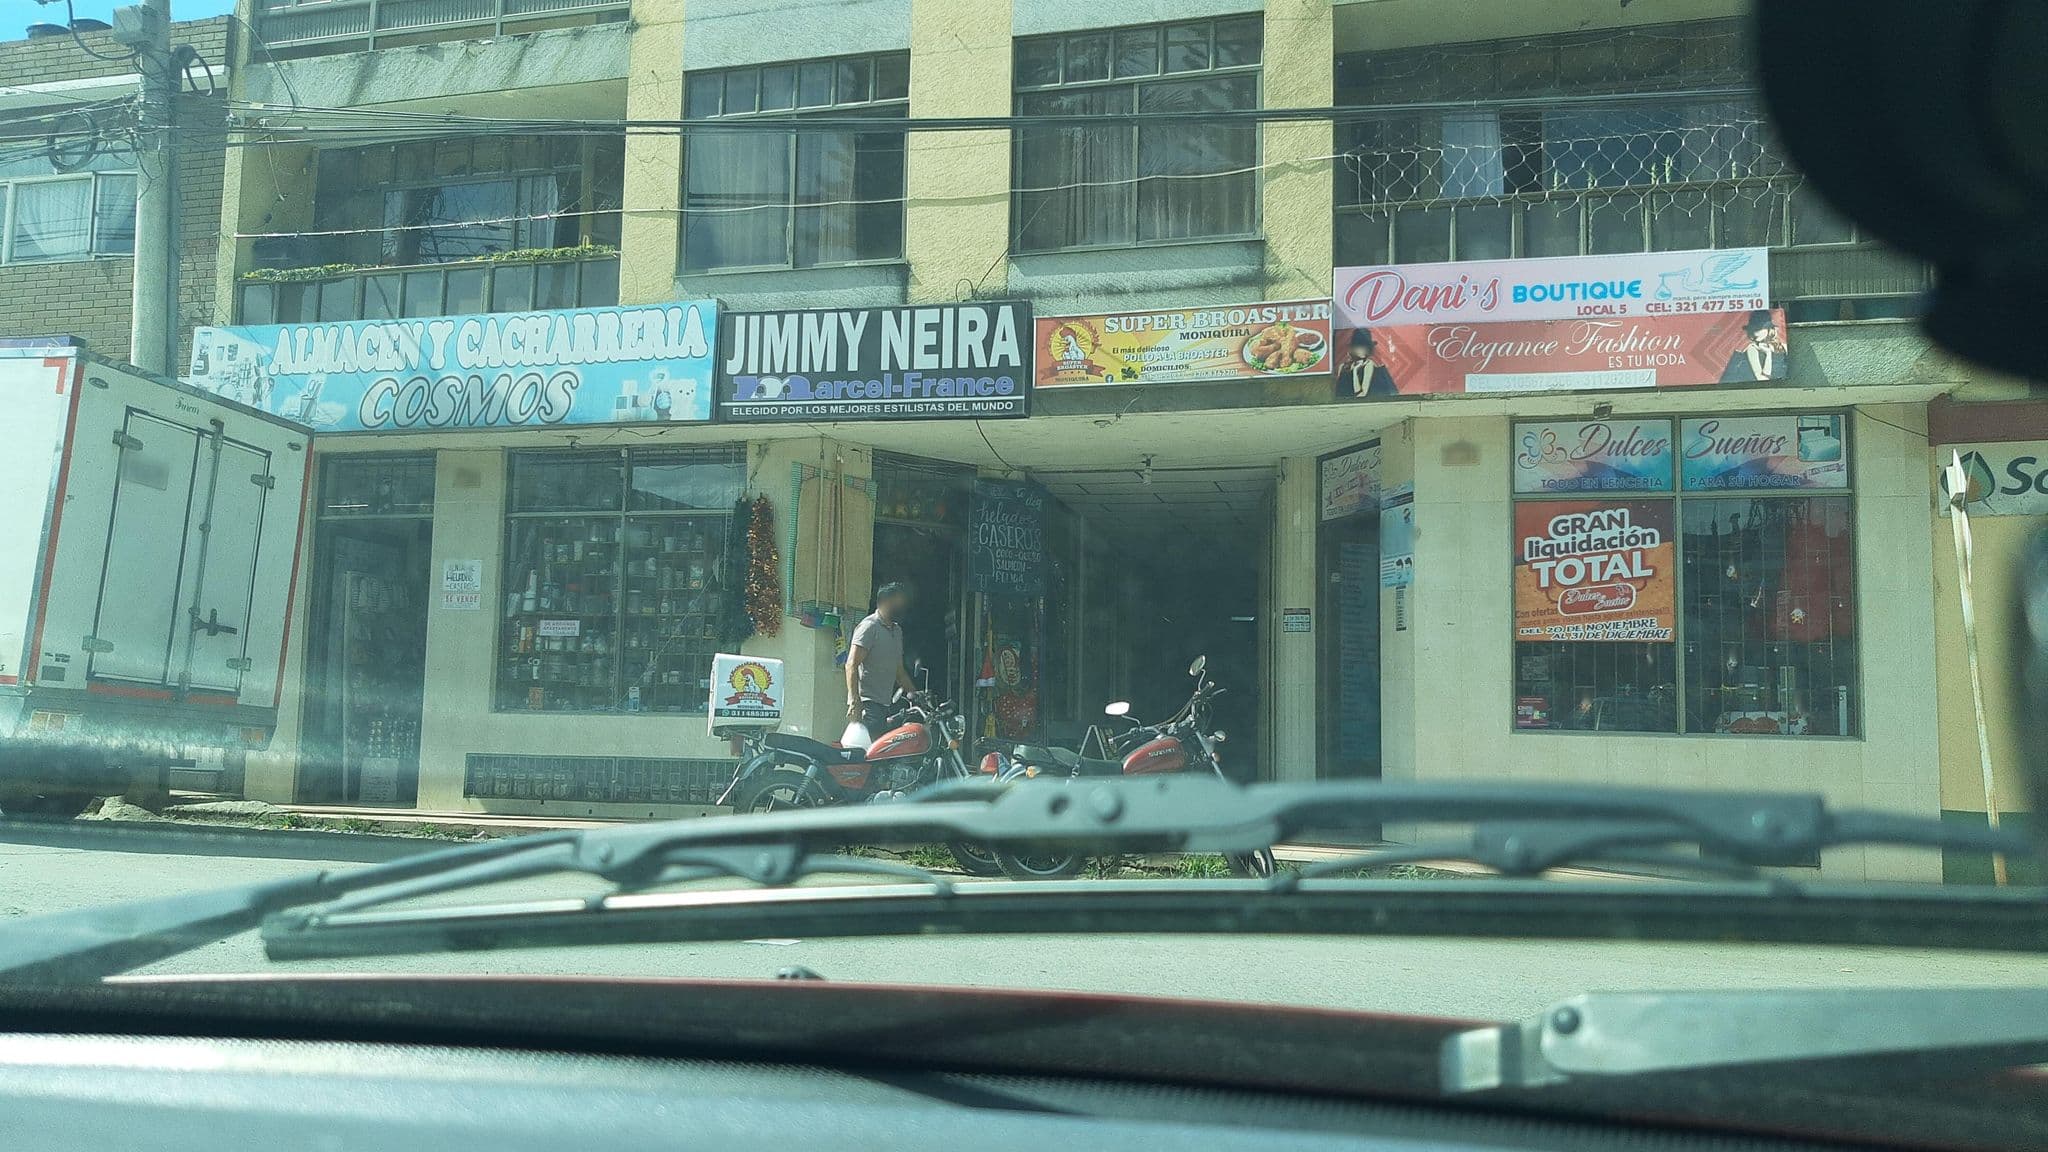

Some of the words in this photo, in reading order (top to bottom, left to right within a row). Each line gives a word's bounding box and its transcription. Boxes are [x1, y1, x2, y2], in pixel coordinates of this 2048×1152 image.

[1345, 269, 1501, 324] Dani's
[1512, 279, 1642, 304] BOUTIQUE
[1577, 304, 1617, 315] LOCAL
[1619, 303, 1627, 314] 5
[1645, 302, 1672, 313] CEL:
[1676, 302, 1697, 312] 321
[1702, 300, 1725, 311] 477
[1729, 299, 1744, 310] 55
[1748, 298, 1763, 309] 10
[1104, 313, 1187, 333] SUPER
[1187, 303, 1331, 328] BROASTER
[269, 320, 424, 375] ALMACEN
[427, 320, 455, 370] Y
[456, 305, 709, 369] CACHARRERIA
[726, 311, 869, 375] JIMMY
[880, 305, 1021, 371] NEIRA
[1427, 325, 1558, 373] Elegance
[1565, 321, 1683, 355] Fashion
[1120, 345, 1136, 354] más
[1136, 345, 1170, 354] delicioso
[1124, 352, 1156, 362] POLLO
[1178, 349, 1229, 360] BROASTER
[1608, 357, 1625, 368] ES
[1627, 355, 1644, 367] TU
[1646, 354, 1686, 367] MODA
[359, 370, 579, 428] COSMOS
[732, 406, 778, 416] ELEGIDO
[781, 405, 803, 415] POR
[806, 405, 828, 414] LOS
[830, 404, 882, 414] MEJORES
[884, 402, 945, 413] ESTILISTAS
[948, 402, 970, 412] DEL
[972, 401, 1014, 411] MUNDO
[1569, 423, 1670, 460] Dulces
[1686, 420, 1789, 460] Sueños
[1541, 479, 1578, 489] TODO
[1581, 478, 1599, 489] EN
[1689, 477, 1726, 488] PARA
[1728, 476, 1747, 487] SU
[1749, 475, 1801, 487] HOGAR
[1552, 511, 1626, 537] GRAN
[1528, 529, 1656, 560] liquidación
[1532, 551, 1653, 588] TOTAL
[1532, 607, 1558, 618] oferta
[1546, 626, 1564, 634] 20
[1566, 625, 1583, 633] DE
[1586, 618, 1657, 631] NOVIEMBRE
[1606, 628, 1671, 639] DICIEMBRE
